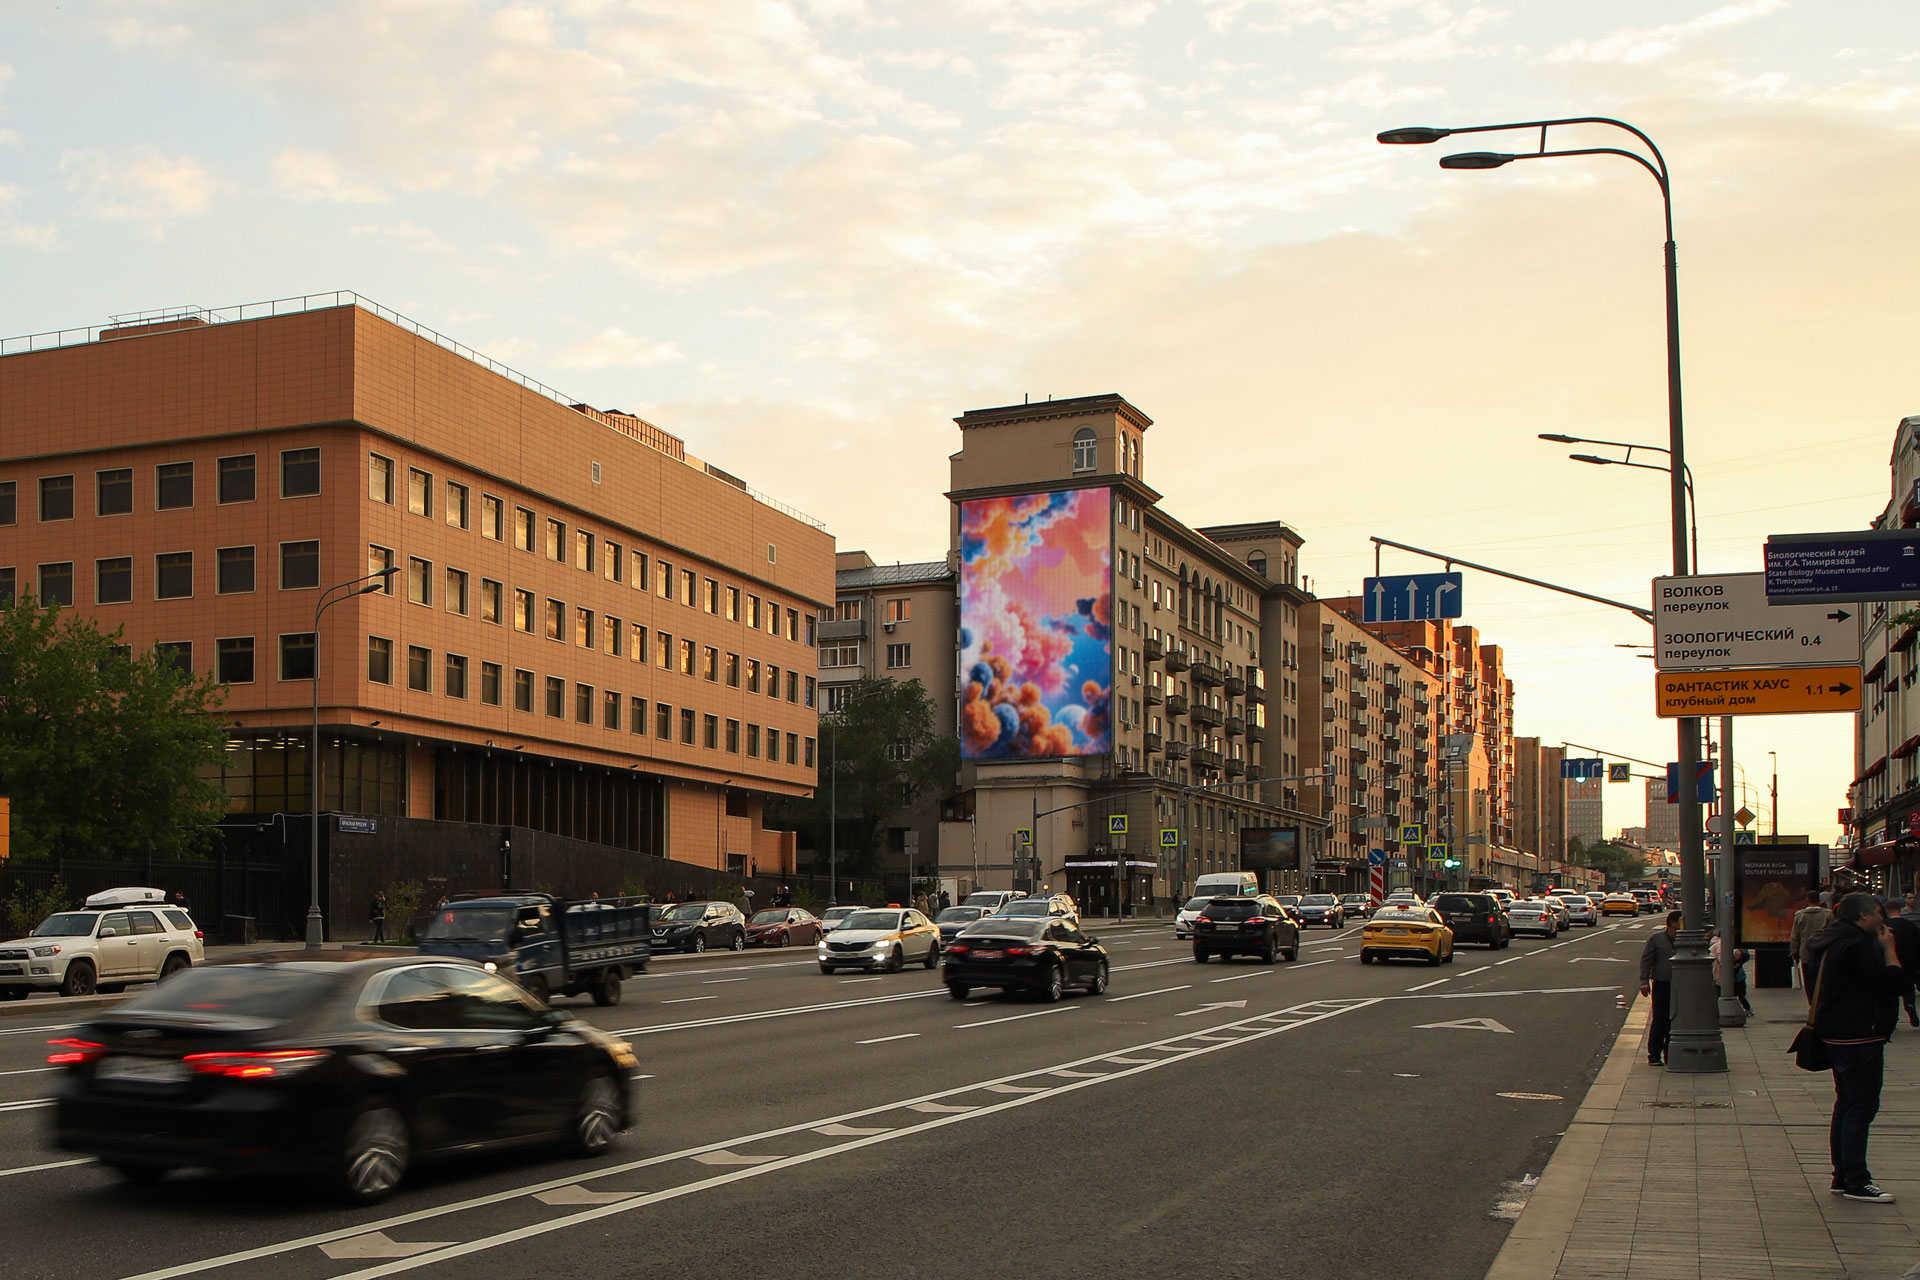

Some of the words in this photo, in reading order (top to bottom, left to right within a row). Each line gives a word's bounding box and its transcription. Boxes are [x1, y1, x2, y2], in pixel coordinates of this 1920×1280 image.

[1768, 549, 1836, 559] Биологический
[1838, 548, 1865, 558] музей
[1802, 559, 1856, 567] Тимирязева
[1788, 569, 1814, 578] Biology
[1663, 585, 1724, 598] ВОЛКОВ
[1663, 601, 1730, 614] переулок
[1664, 627, 1795, 645] ЗООЛОГИЧЕСКИЙ
[1801, 636, 1822, 646] 0.4
[1665, 647, 1731, 660] переулок
[1665, 680, 1749, 693] ФАНТАСТИК
[1753, 679, 1790, 690] ХАУС
[1806, 685, 1824, 695] 1.1
[1665, 696, 1725, 708] клубный
[1729, 696, 1756, 706] дом
